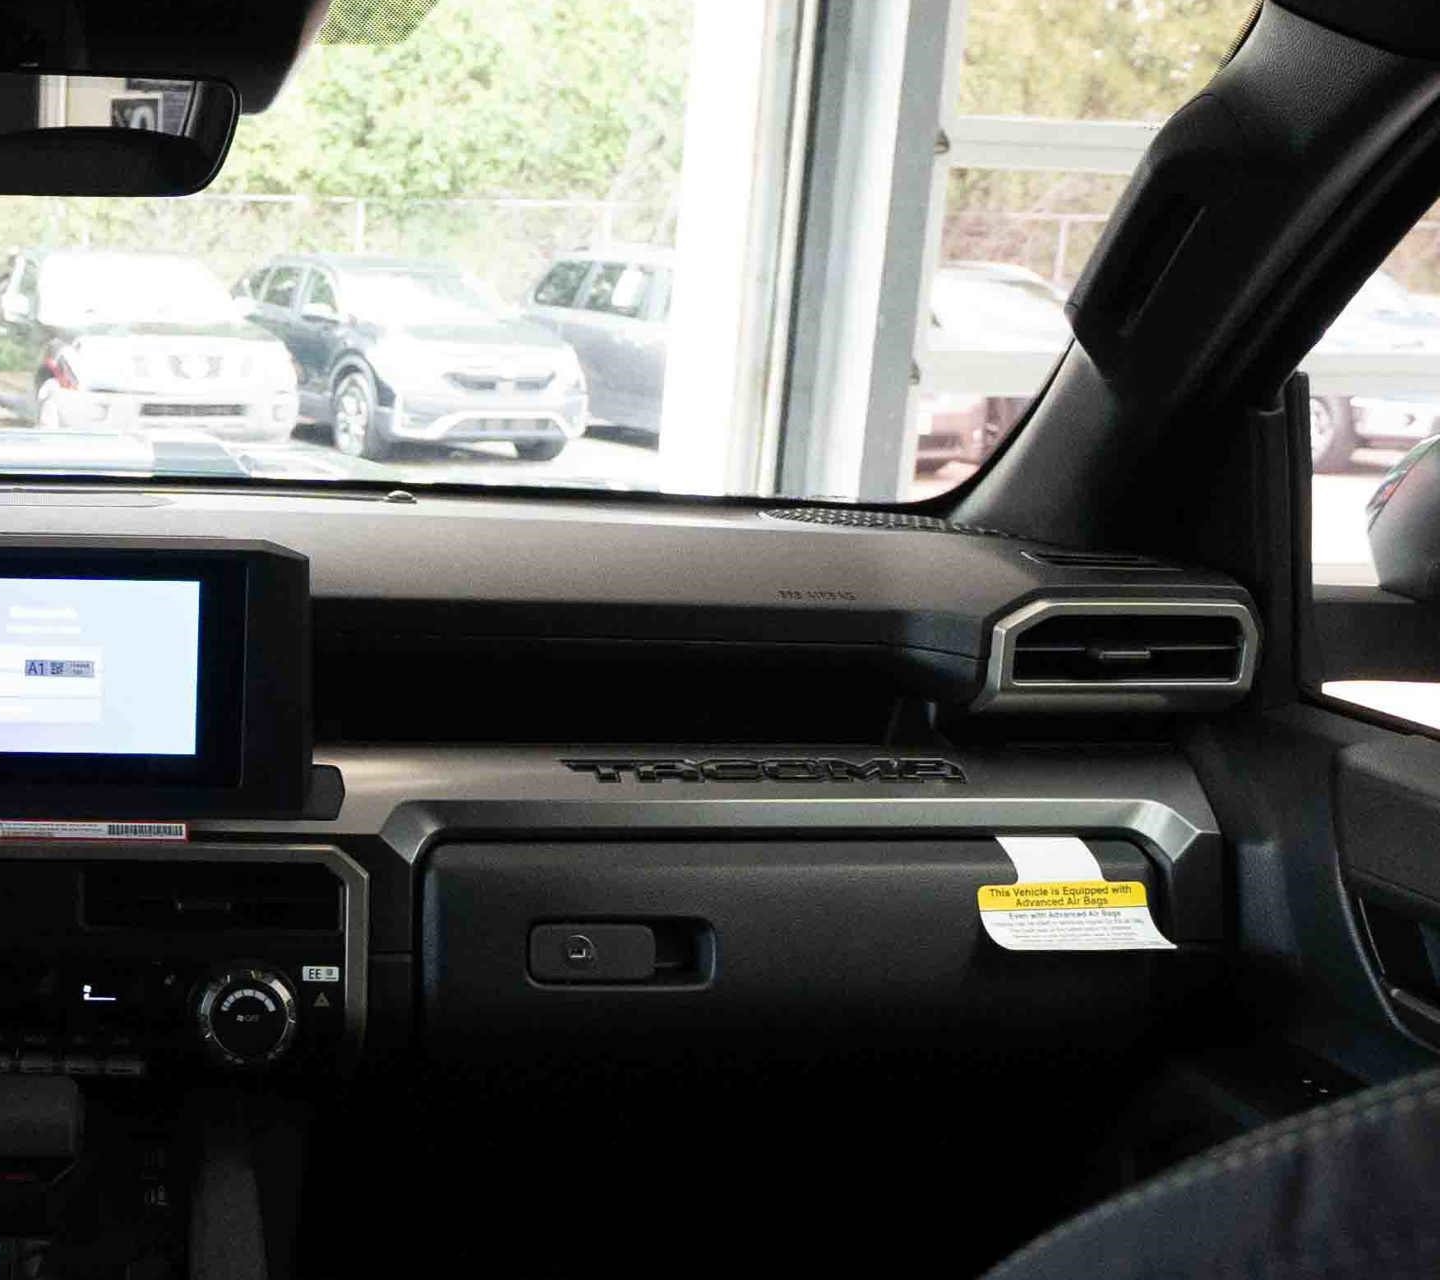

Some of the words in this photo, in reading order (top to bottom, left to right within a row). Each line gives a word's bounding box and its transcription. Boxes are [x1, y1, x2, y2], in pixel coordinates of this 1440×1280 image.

[28, 661, 45, 675] A1
[560, 756, 968, 785] TACOMA
[988, 888, 1010, 897] This
[1013, 887, 1048, 897] Vehicle
[1051, 887, 1060, 896] is
[1062, 886, 1109, 897] Equipped
[1111, 885, 1132, 894] with
[1016, 898, 1064, 907] Advanced
[1067, 897, 1080, 906] Air
[1083, 896, 1108, 907] Bags
[1048, 910, 1088, 919] Advanced
[308, 968, 321, 980] EE
